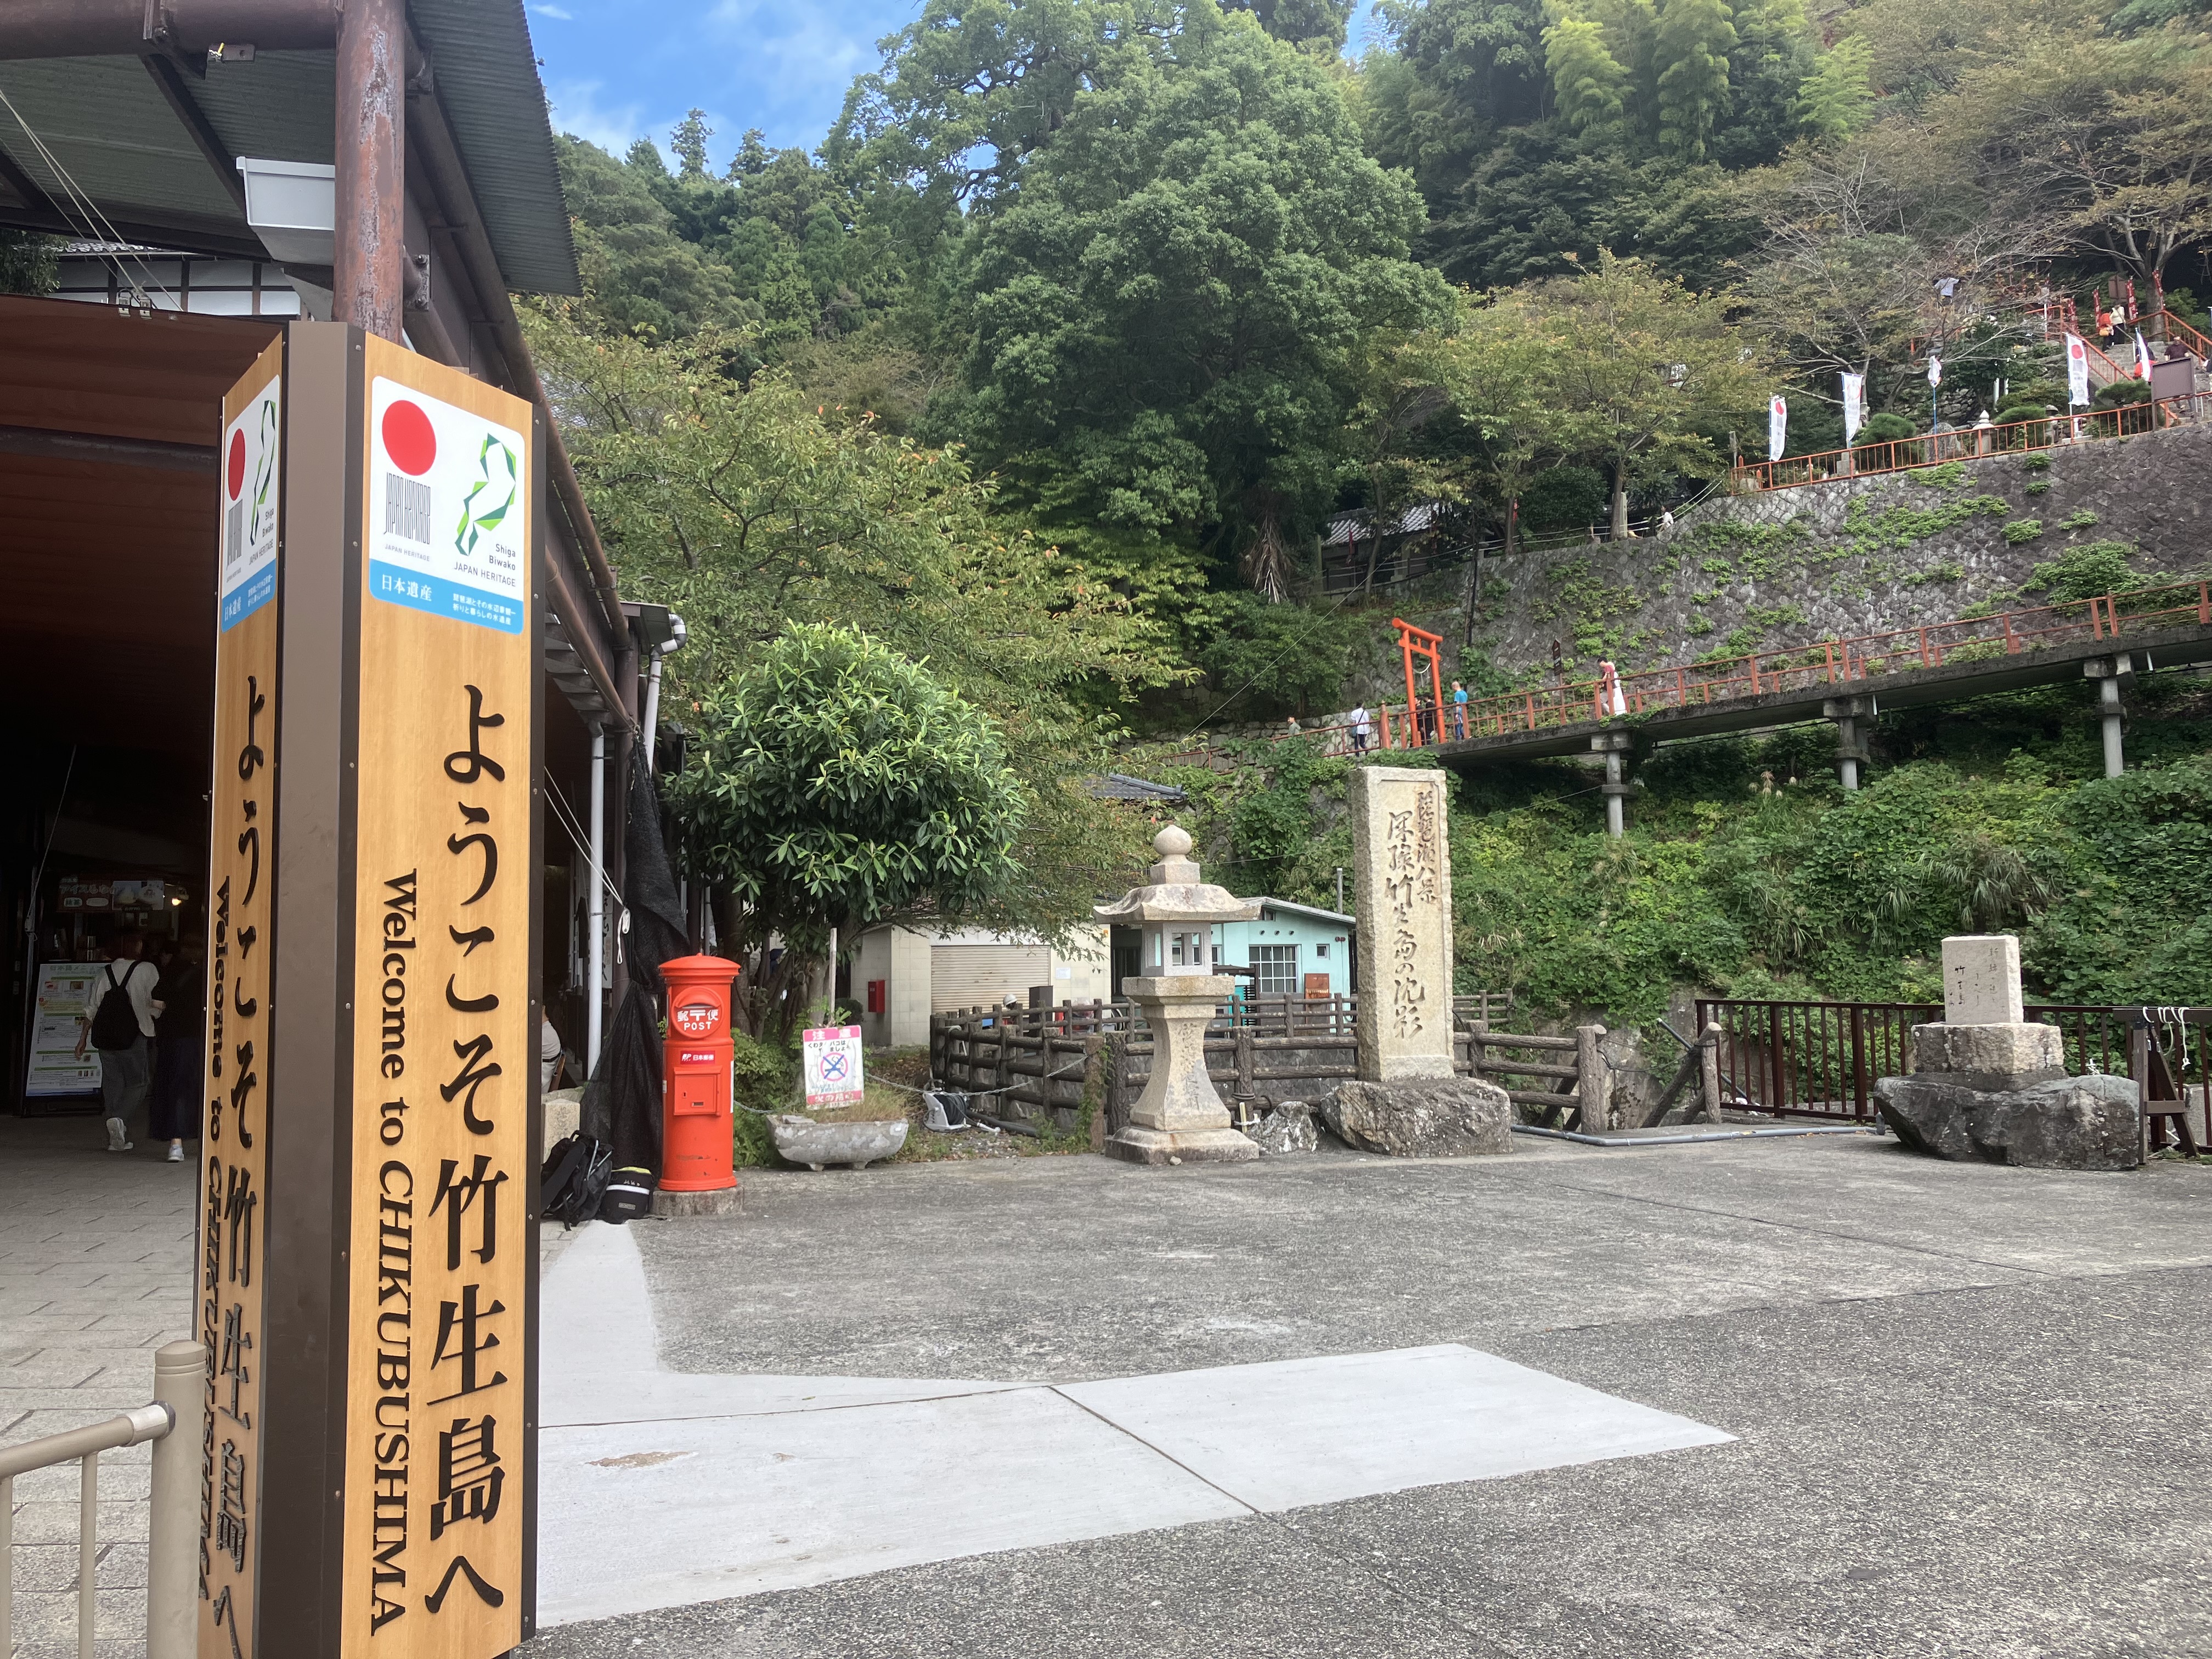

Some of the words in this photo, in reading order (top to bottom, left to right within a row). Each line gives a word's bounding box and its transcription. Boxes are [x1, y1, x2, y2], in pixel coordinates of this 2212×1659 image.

[385, 544, 402, 554] JAPAN
[404, 549, 430, 562] HERITAGE
[489, 555, 516, 571] Biwako
[495, 543, 516, 557] Shiga
[382, 574, 432, 602] 日本遺産
[454, 562, 478, 576] JAPAN
[481, 569, 516, 587] HERITAGE
[214, 876, 229, 1079] Welcome
[381, 868, 417, 1080] Welcome
[684, 1021, 712, 1031] POST
[210, 1096, 222, 1142] to
[380, 1097, 410, 1146] to
[424, 684, 509, 1615] ようこそ竹生島へ
[371, 1160, 414, 1637] CHIKUBUSHIMA
